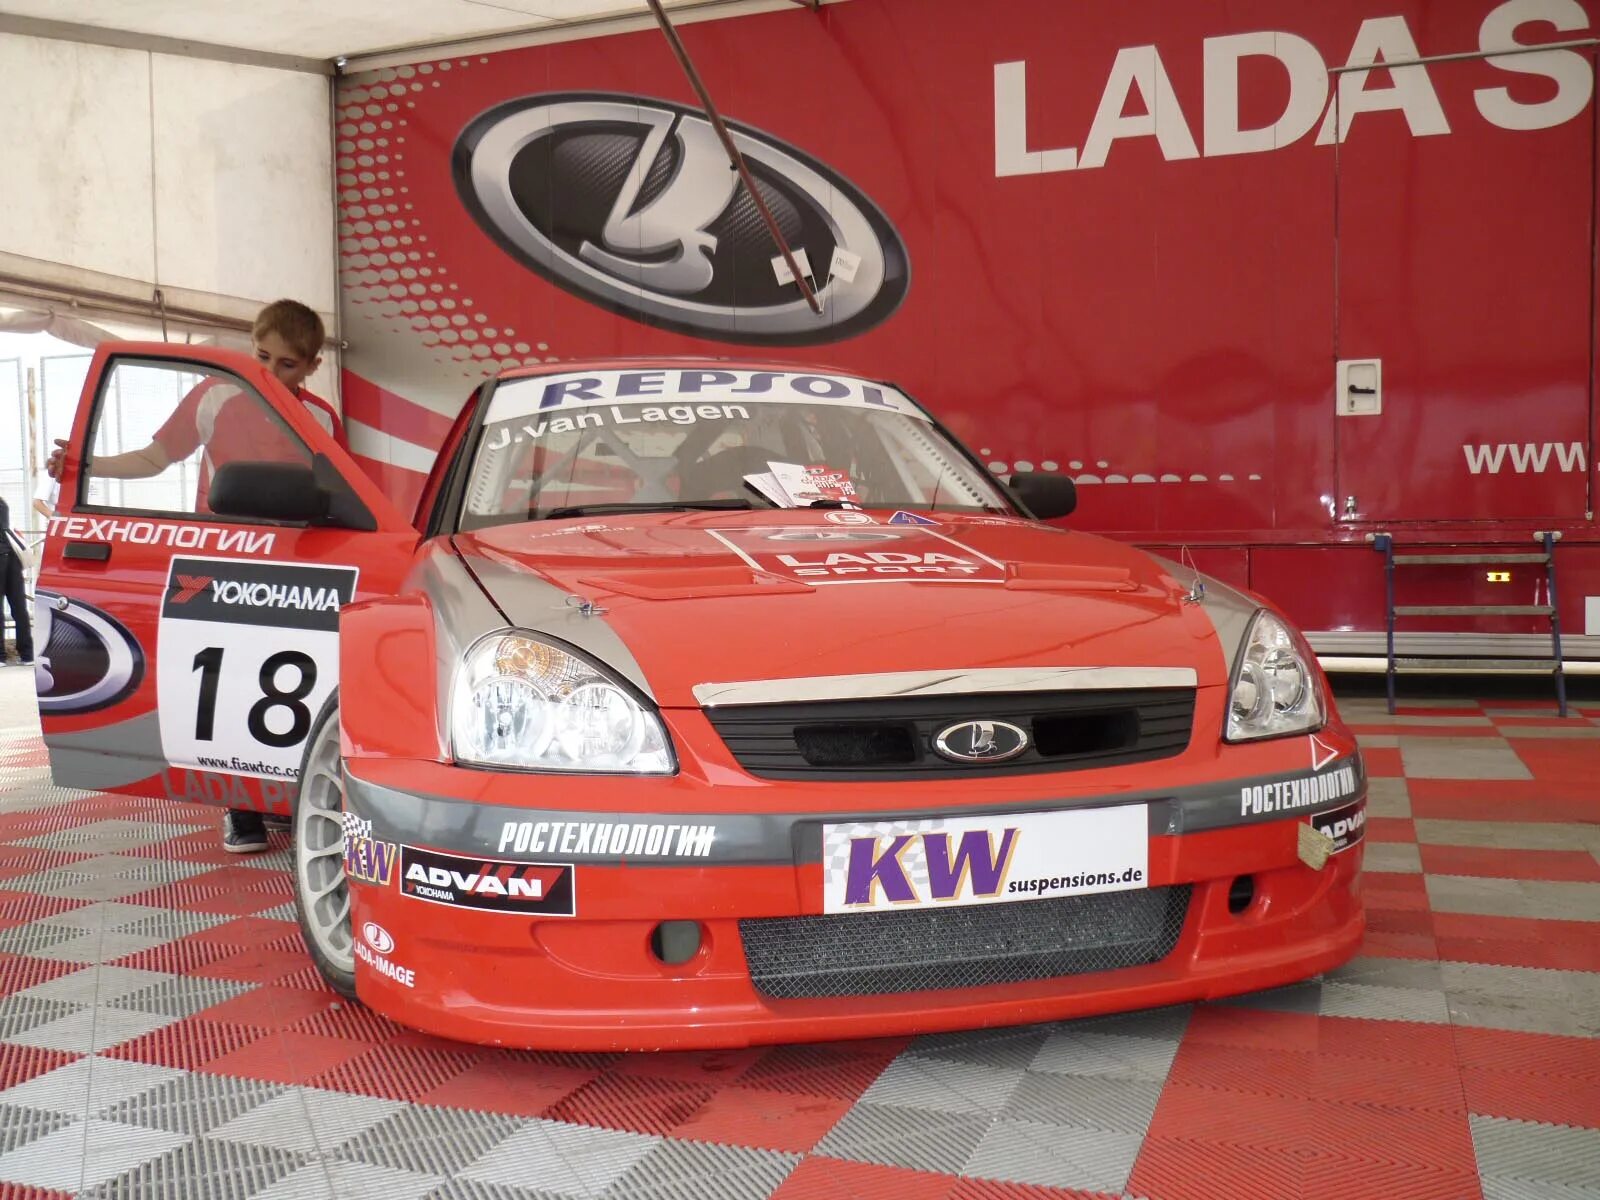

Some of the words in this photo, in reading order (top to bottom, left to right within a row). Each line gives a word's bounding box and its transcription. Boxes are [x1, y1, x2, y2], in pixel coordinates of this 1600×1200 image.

[993, 15, 1452, 178] LADA
[538, 371, 901, 411] REPSOL
[610, 403, 750, 425] Lagen
[49, 516, 275, 555] ТЕХНОЛОГИИ
[776, 552, 974, 567] LADA
[793, 566, 980, 576] SPORT
[211, 580, 341, 612] YOKOHAMA
[192, 646, 318, 748] 18
[160, 767, 257, 813] LADA
[1241, 766, 1355, 817] РОСТЕХНОЛОГИИ
[498, 821, 716, 857] РОСТЕХНОЛОГИИ
[346, 834, 397, 886] KW
[843, 827, 1021, 908] KW
[1008, 868, 1143, 896] suspensions.de
[405, 862, 543, 898] ADVAN
[415, 884, 455, 902] YOKOHAMA
[353, 936, 416, 988] LADA-IMAGE
